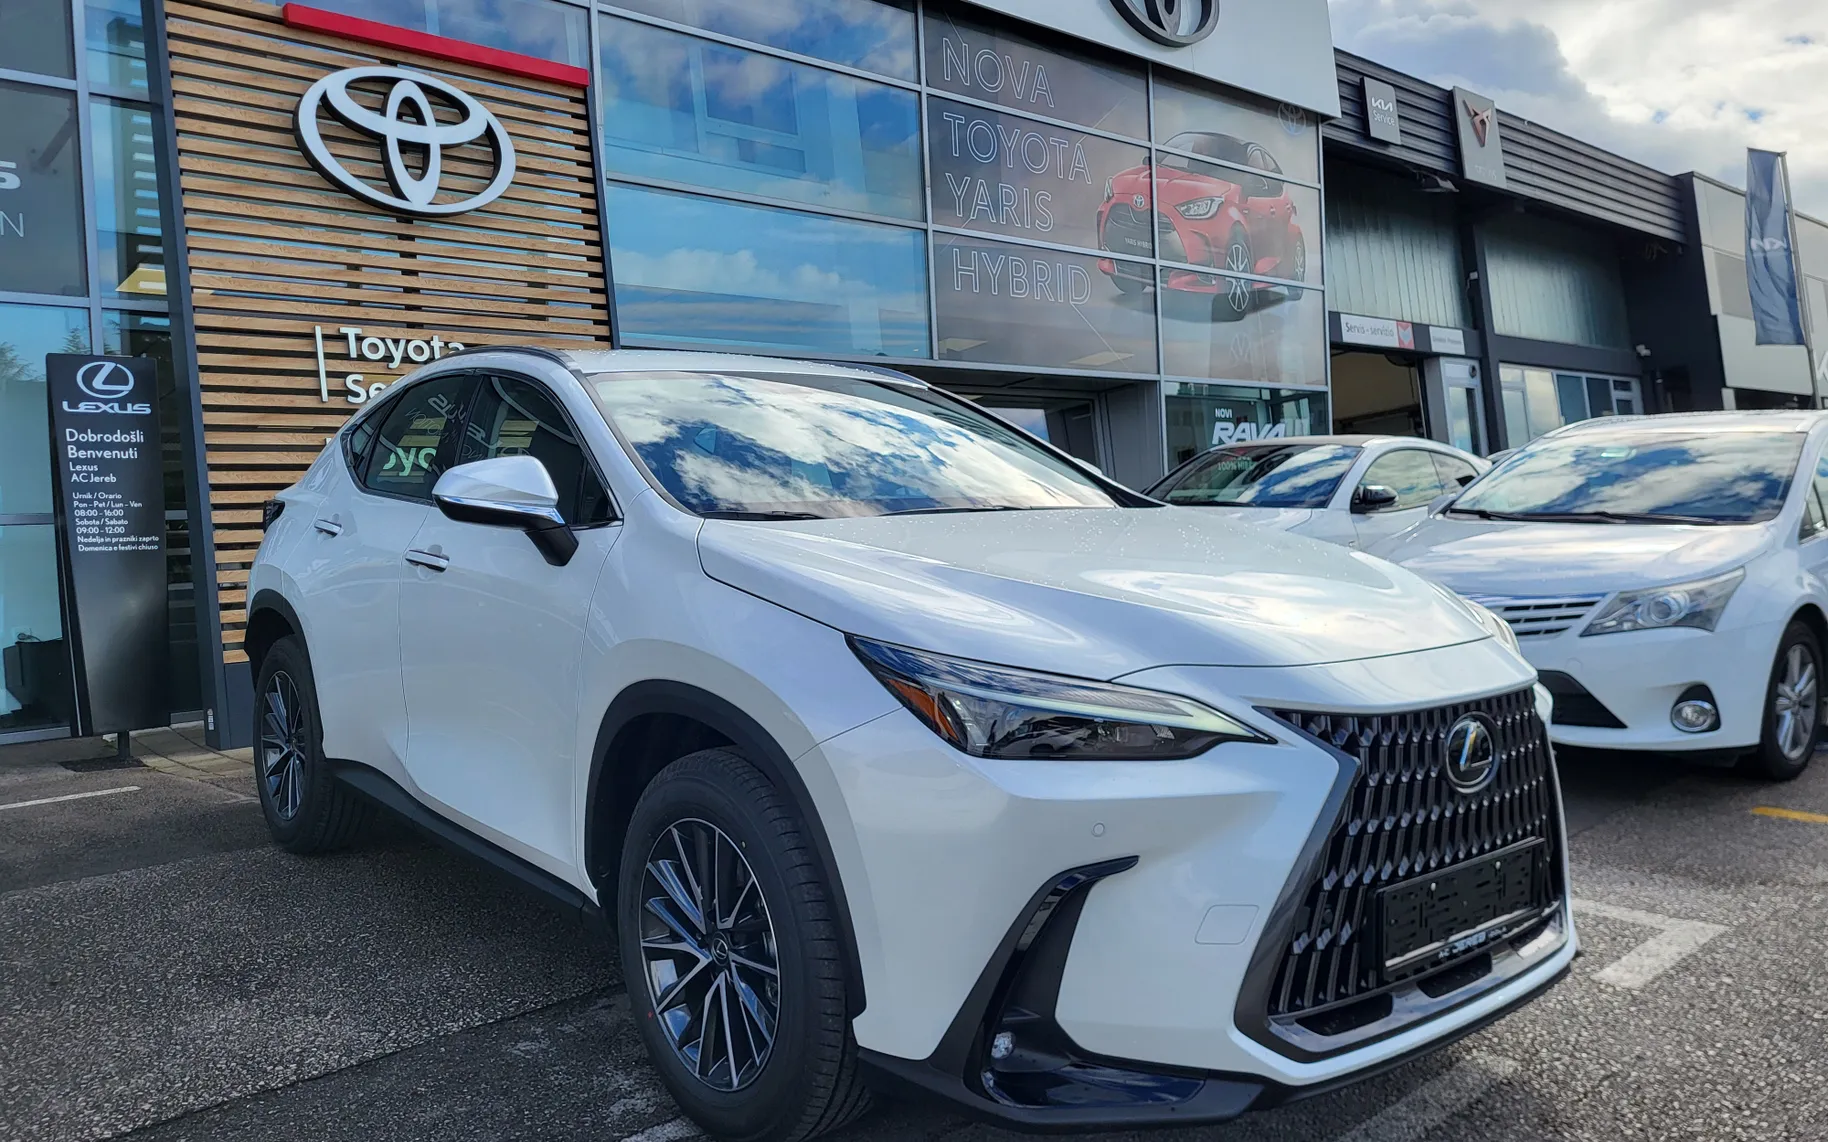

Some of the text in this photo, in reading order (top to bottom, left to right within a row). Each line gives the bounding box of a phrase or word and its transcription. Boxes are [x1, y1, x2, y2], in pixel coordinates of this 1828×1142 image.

[943, 37, 1054, 108] NOVA
[1373, 109, 1395, 126] Service
[943, 112, 1092, 185] TOYOTA
[945, 173, 1054, 232] YARIS
[953, 248, 1092, 305] HYBRID
[1345, 321, 1366, 335] Servis
[62, 400, 152, 415] LEXUS
[1214, 407, 1233, 419] NOVI
[65, 428, 144, 443] Dobrodošli
[67, 444, 138, 459] Benvenuti
[69, 461, 99, 472] Lexus
[70, 472, 117, 483] AC Jereb
[98, 491, 122, 499] Orario
[73, 500, 88, 508] Pon
[93, 500, 106, 508] Pet
[111, 500, 124, 508] Lun
[129, 500, 143, 508] Ven
[74, 509, 98, 517] 08:00
[103, 509, 124, 517] 16:00
[75, 518, 100, 526] Sobota
[105, 517, 129, 525] Sabato
[76, 526, 100, 534] 09:00
[105, 526, 126, 534] 12:00
[77, 535, 159, 544] Nedelja in prazniki zaprto
[78, 544, 113, 552] Domenica
[138, 543, 159, 551] chiuso
